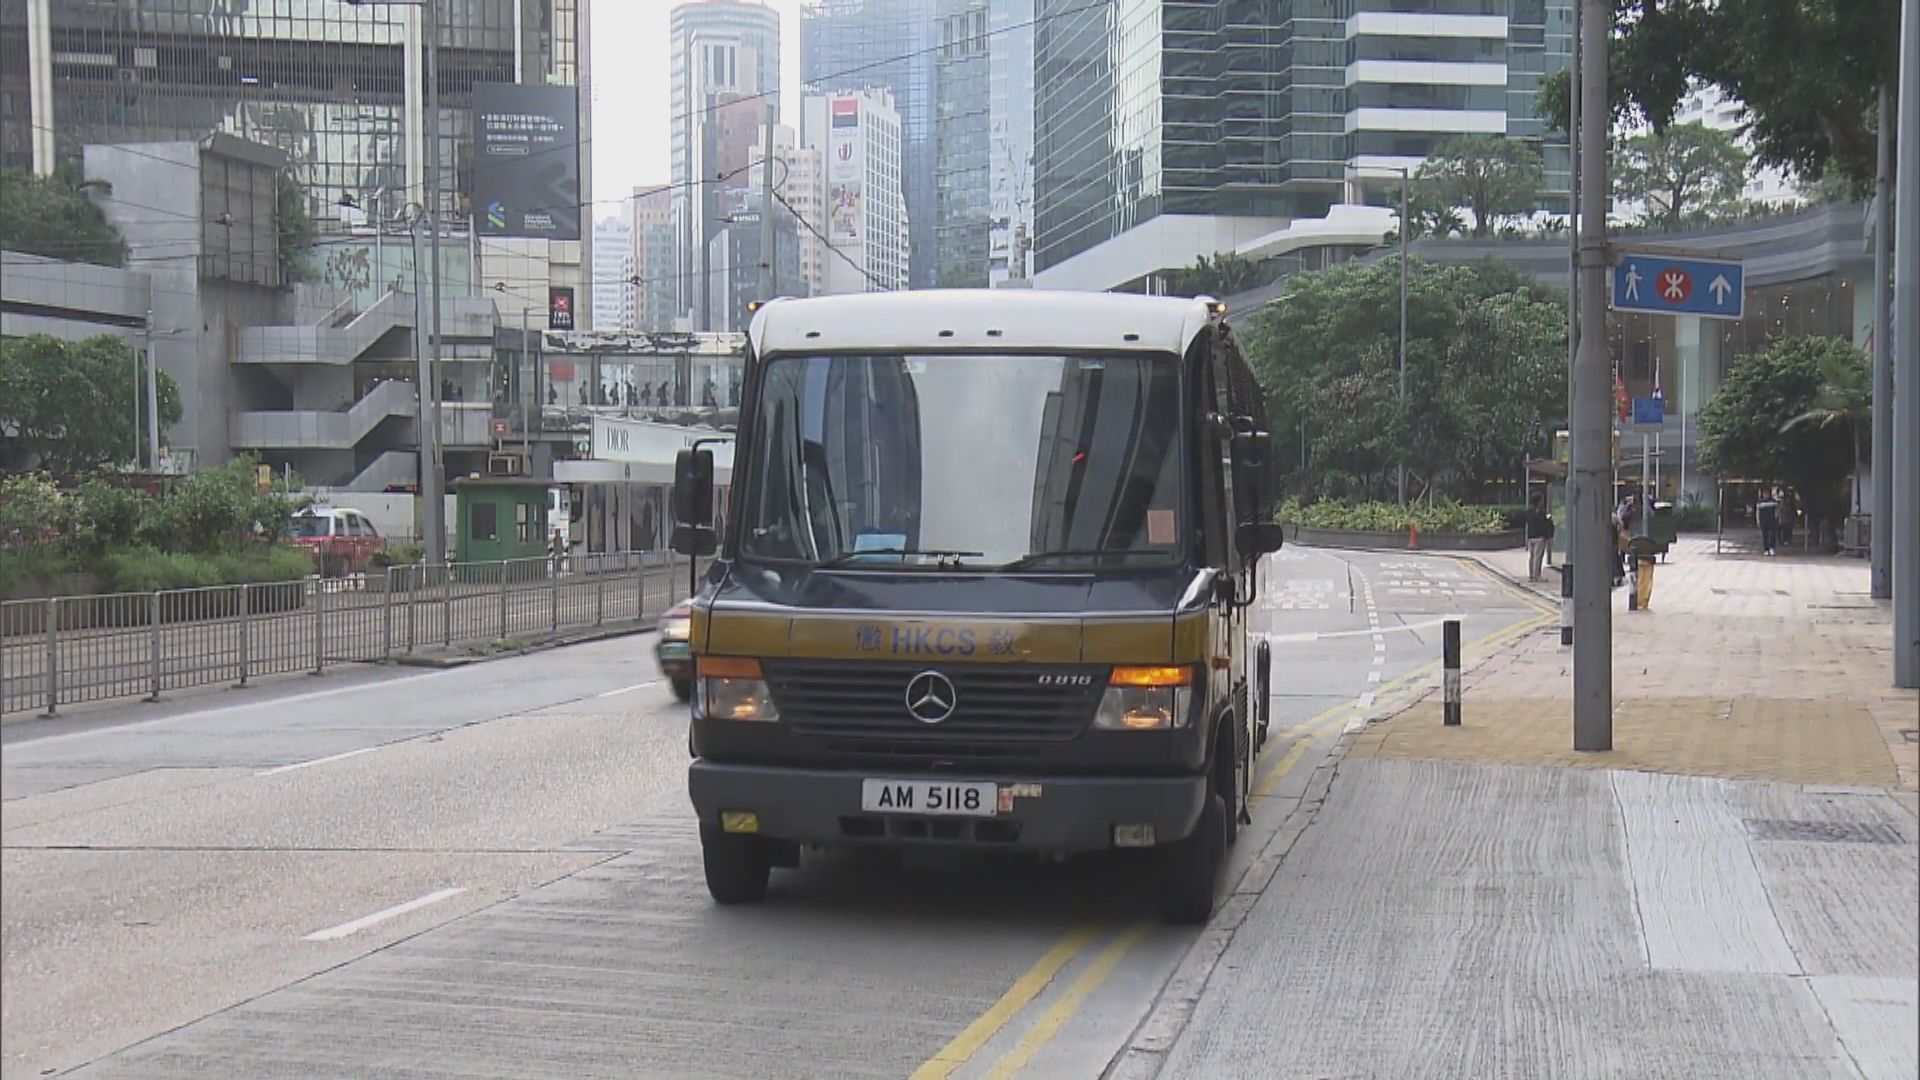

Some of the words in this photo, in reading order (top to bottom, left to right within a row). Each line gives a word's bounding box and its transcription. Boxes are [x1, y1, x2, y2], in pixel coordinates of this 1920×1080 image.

[607, 426, 629, 452] DIOR
[891, 626, 976, 656] HKCS
[878, 785, 914, 809] AM
[926, 786, 981, 811] 5118
